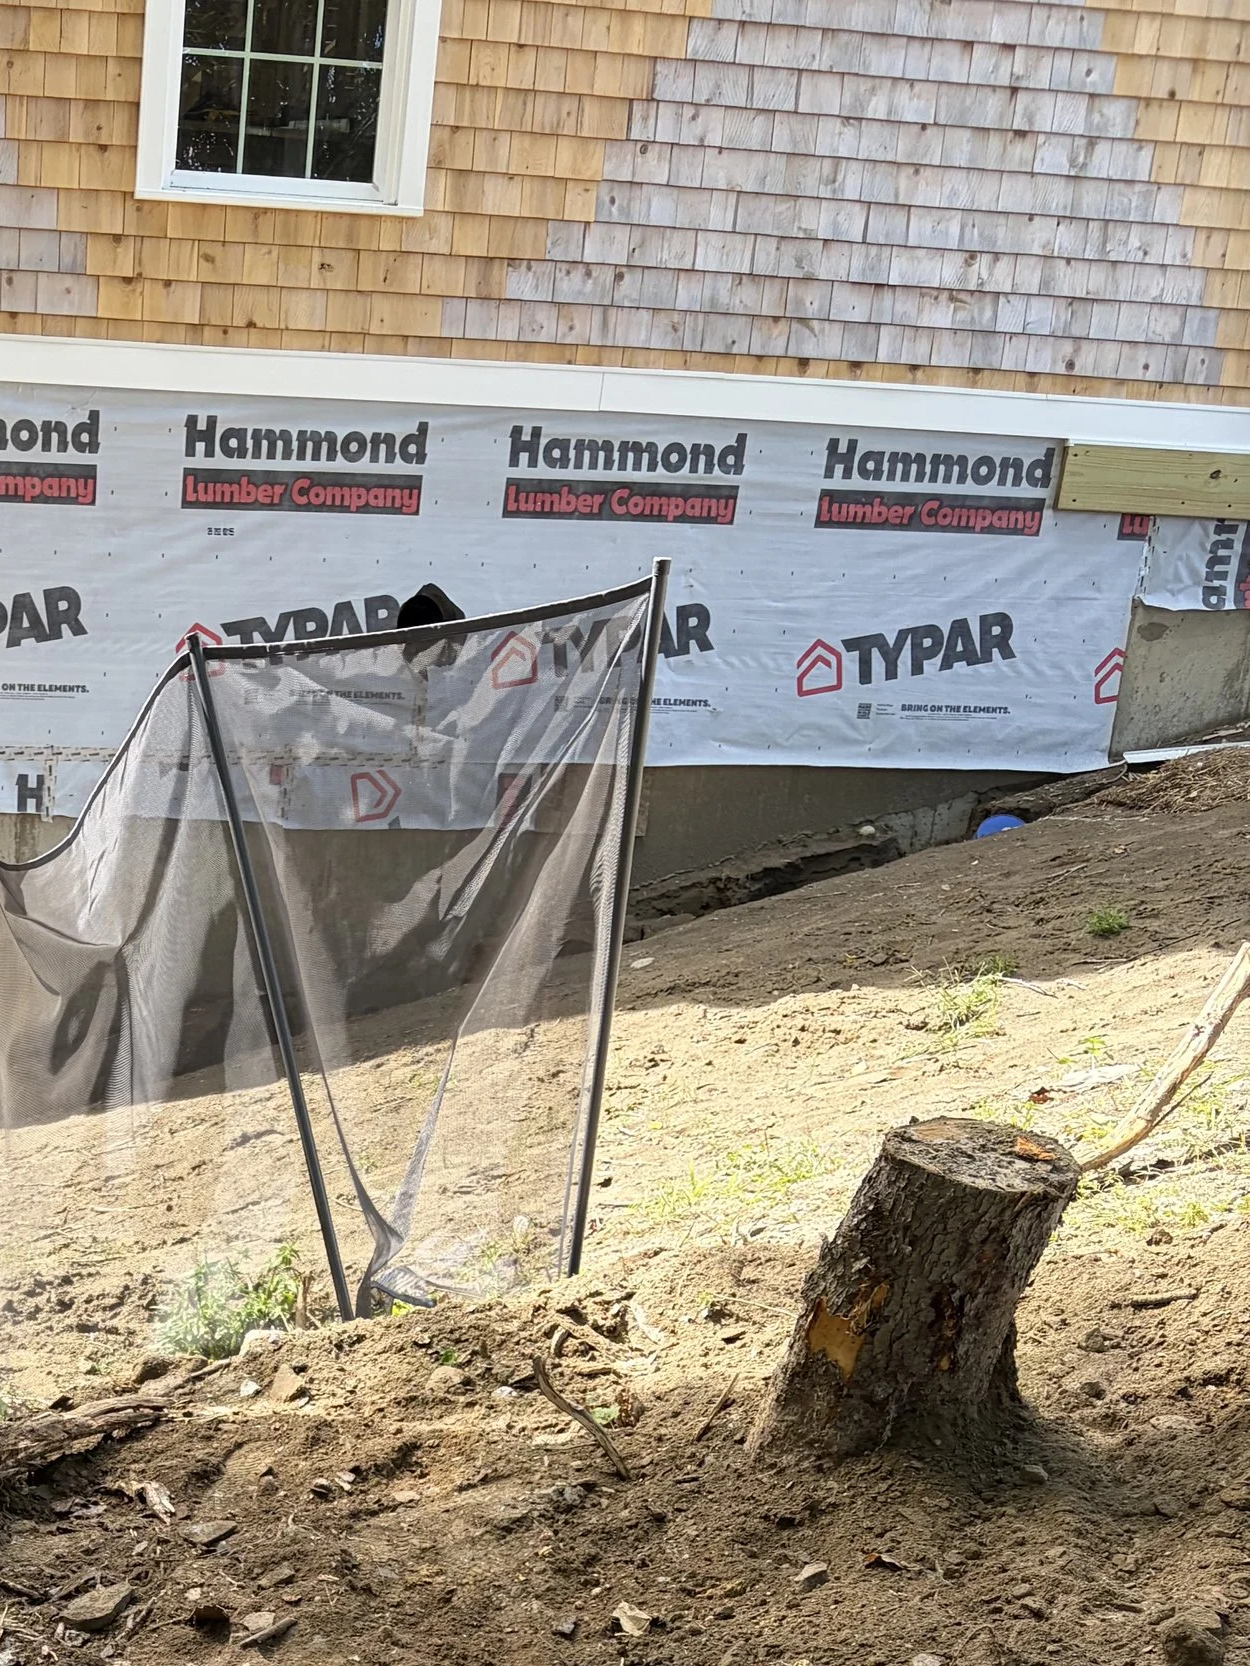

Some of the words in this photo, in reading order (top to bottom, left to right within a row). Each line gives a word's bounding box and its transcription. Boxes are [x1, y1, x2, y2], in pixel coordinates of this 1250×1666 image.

[184, 414, 429, 464] Hammond
[508, 425, 748, 476] Hammond
[823, 438, 1056, 489] Hammond
[185, 475, 285, 504] Lumber
[291, 478, 419, 514] Company
[506, 484, 605, 513] Lumber
[610, 488, 735, 524] Company
[819, 496, 915, 525] Lumber
[920, 499, 1041, 536] Company
[841, 612, 1017, 685] TYPAR
[1, 683, 16, 691] ON
[17, 683, 36, 692] THE
[37, 684, 90, 693] ELEMENTS.
[663, 698, 711, 708] ELEMENTS.
[901, 703, 929, 713] BRING
[930, 704, 943, 713] ON
[945, 704, 961, 714] THE
[963, 705, 1011, 715] ELEMENTS.
